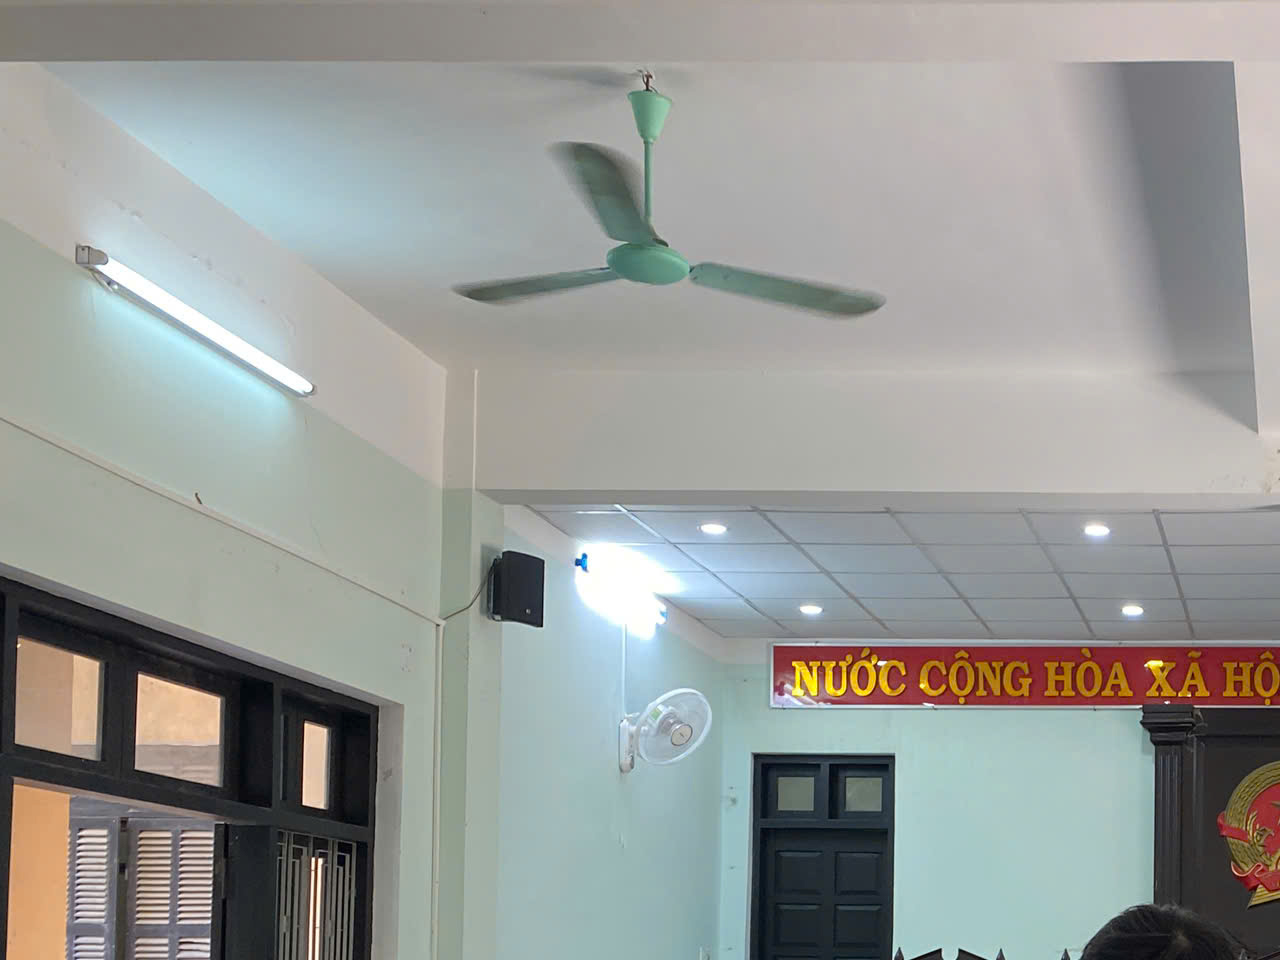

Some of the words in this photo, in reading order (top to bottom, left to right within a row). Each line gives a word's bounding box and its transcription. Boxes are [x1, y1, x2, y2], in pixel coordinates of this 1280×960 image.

[792, 648, 906, 697] NƯỚC
[919, 650, 1032, 704] CỘNG
[1044, 648, 1133, 697] HÒA
[1144, 650, 1210, 697] XÃ
